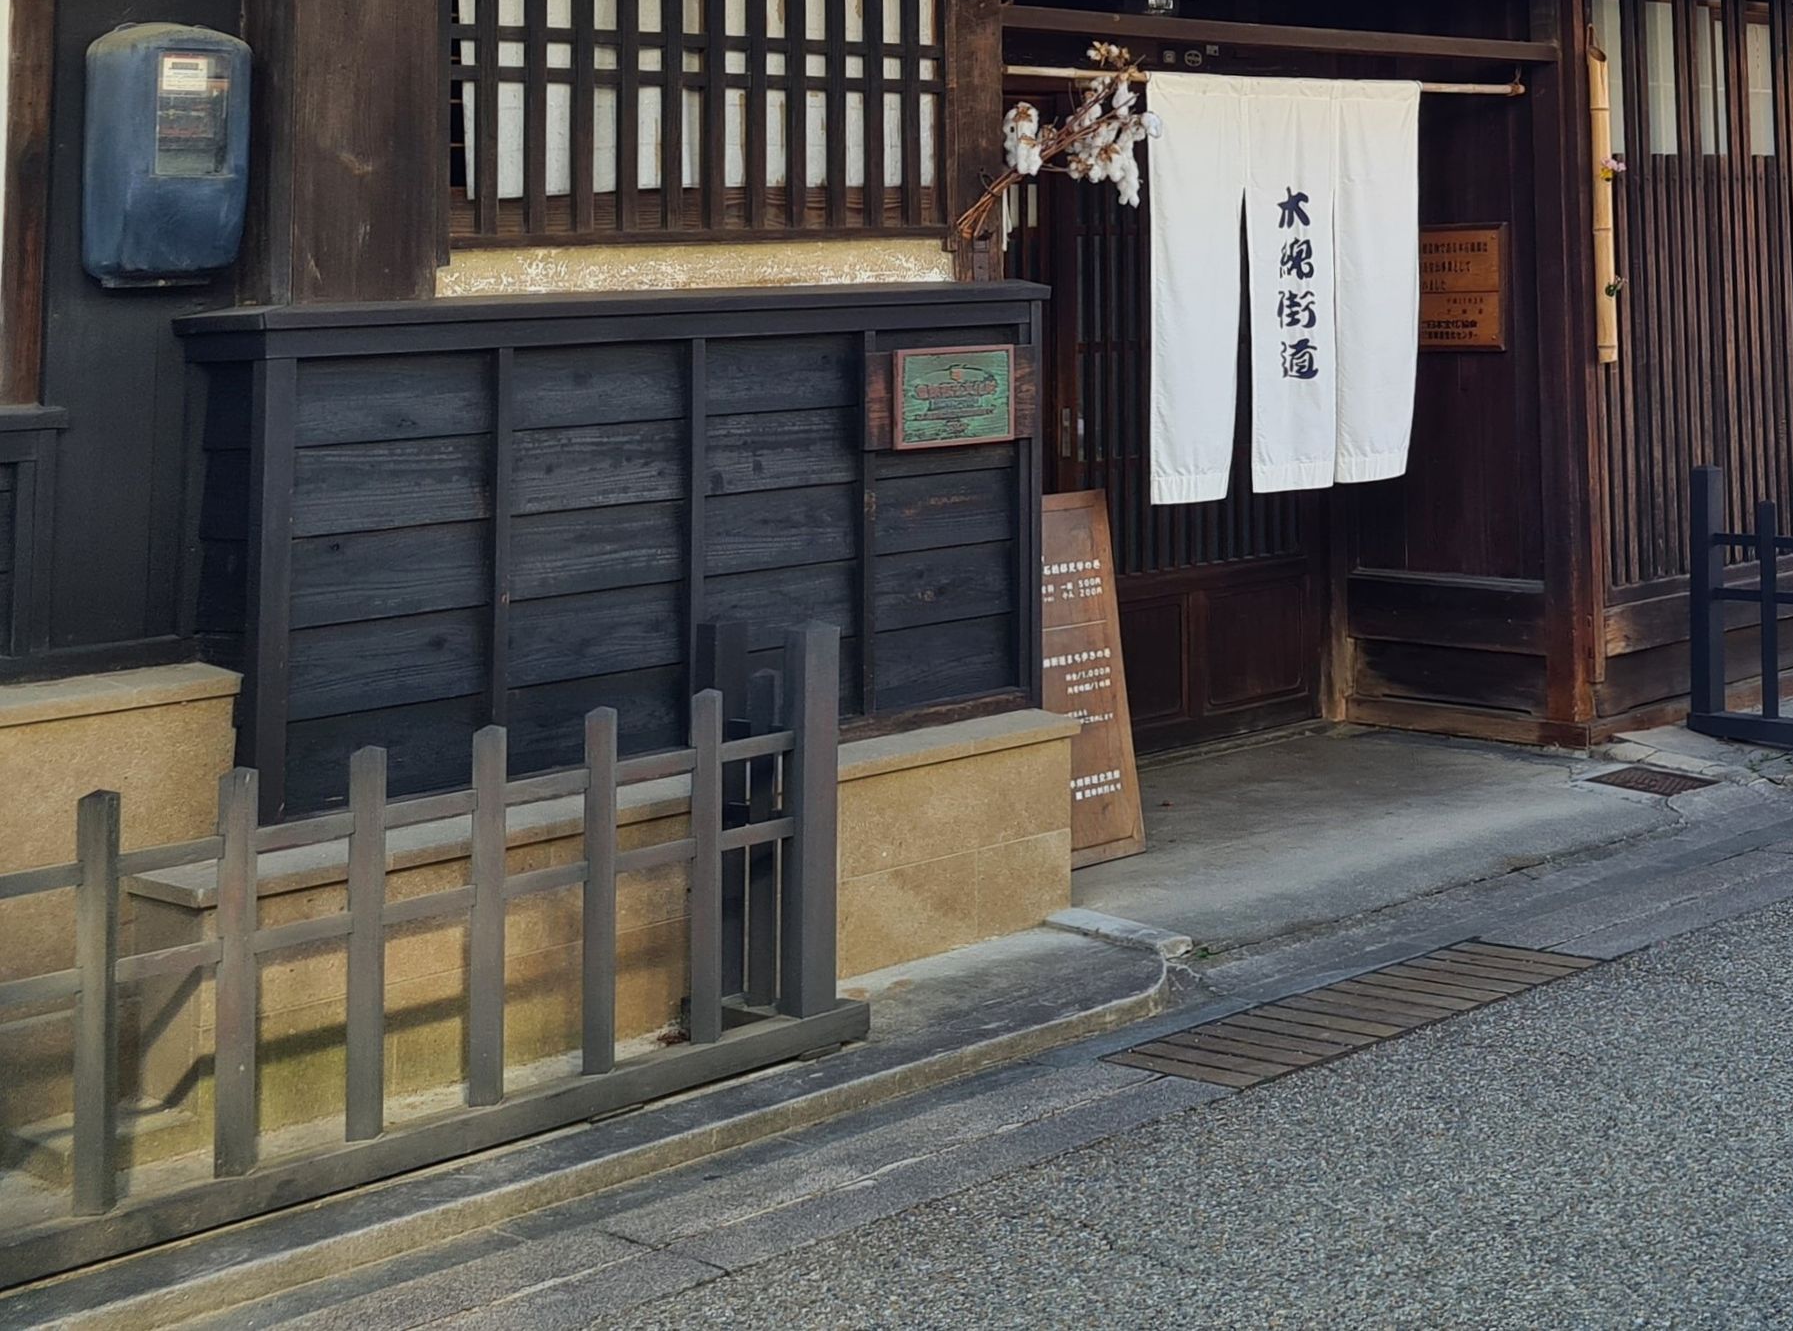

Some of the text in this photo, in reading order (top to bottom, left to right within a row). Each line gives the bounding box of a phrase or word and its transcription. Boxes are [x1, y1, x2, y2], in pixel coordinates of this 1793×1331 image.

[1276, 186, 1319, 380] 木綿街道
[1078, 577, 1102, 588] 500円
[1078, 586, 1103, 597] 200円
